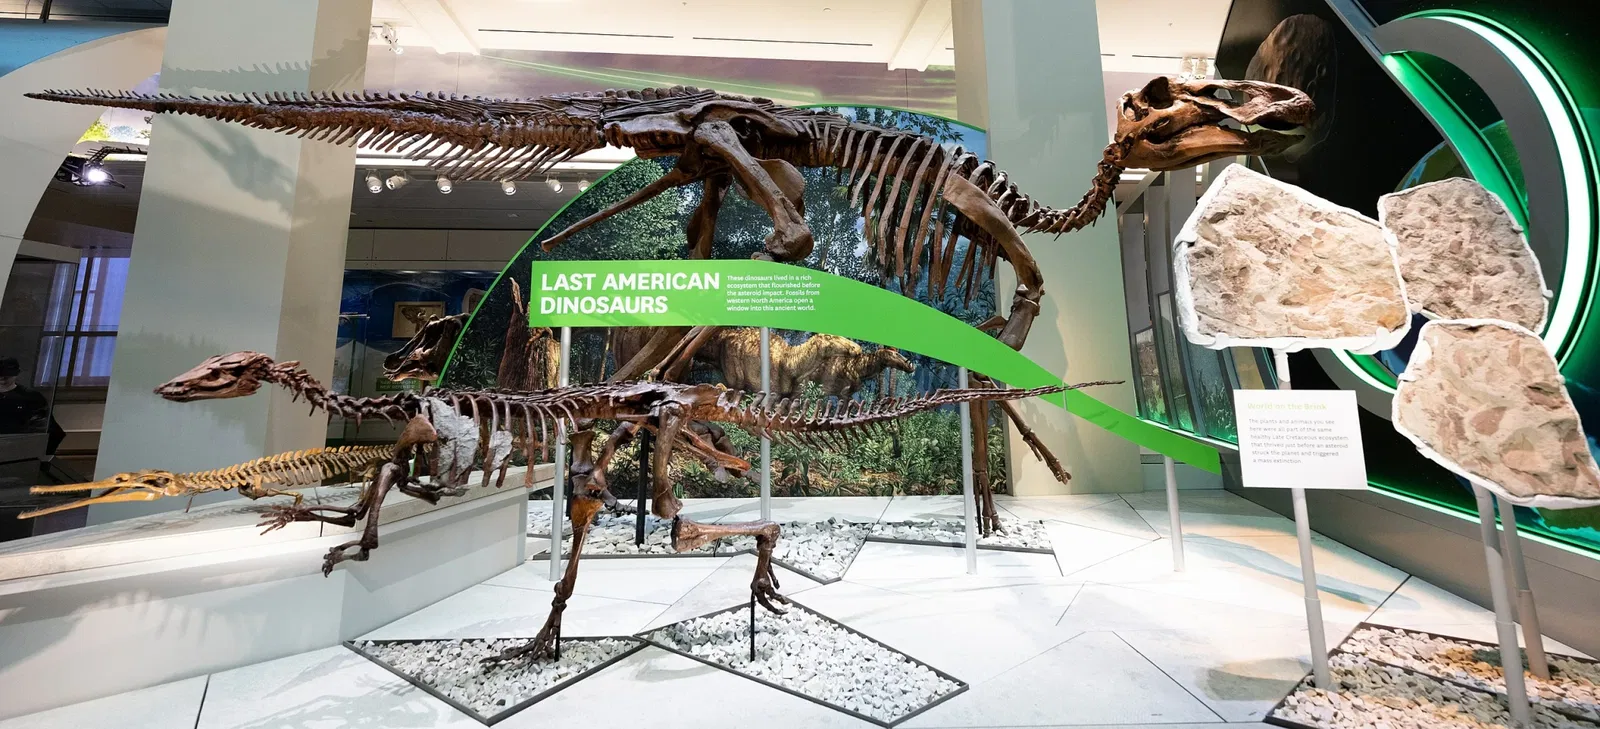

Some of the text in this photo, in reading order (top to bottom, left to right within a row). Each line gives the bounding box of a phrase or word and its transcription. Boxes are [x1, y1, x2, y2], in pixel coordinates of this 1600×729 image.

[542, 272, 719, 291] LAST AMERICAN
[541, 296, 668, 314] DINOSAURS
